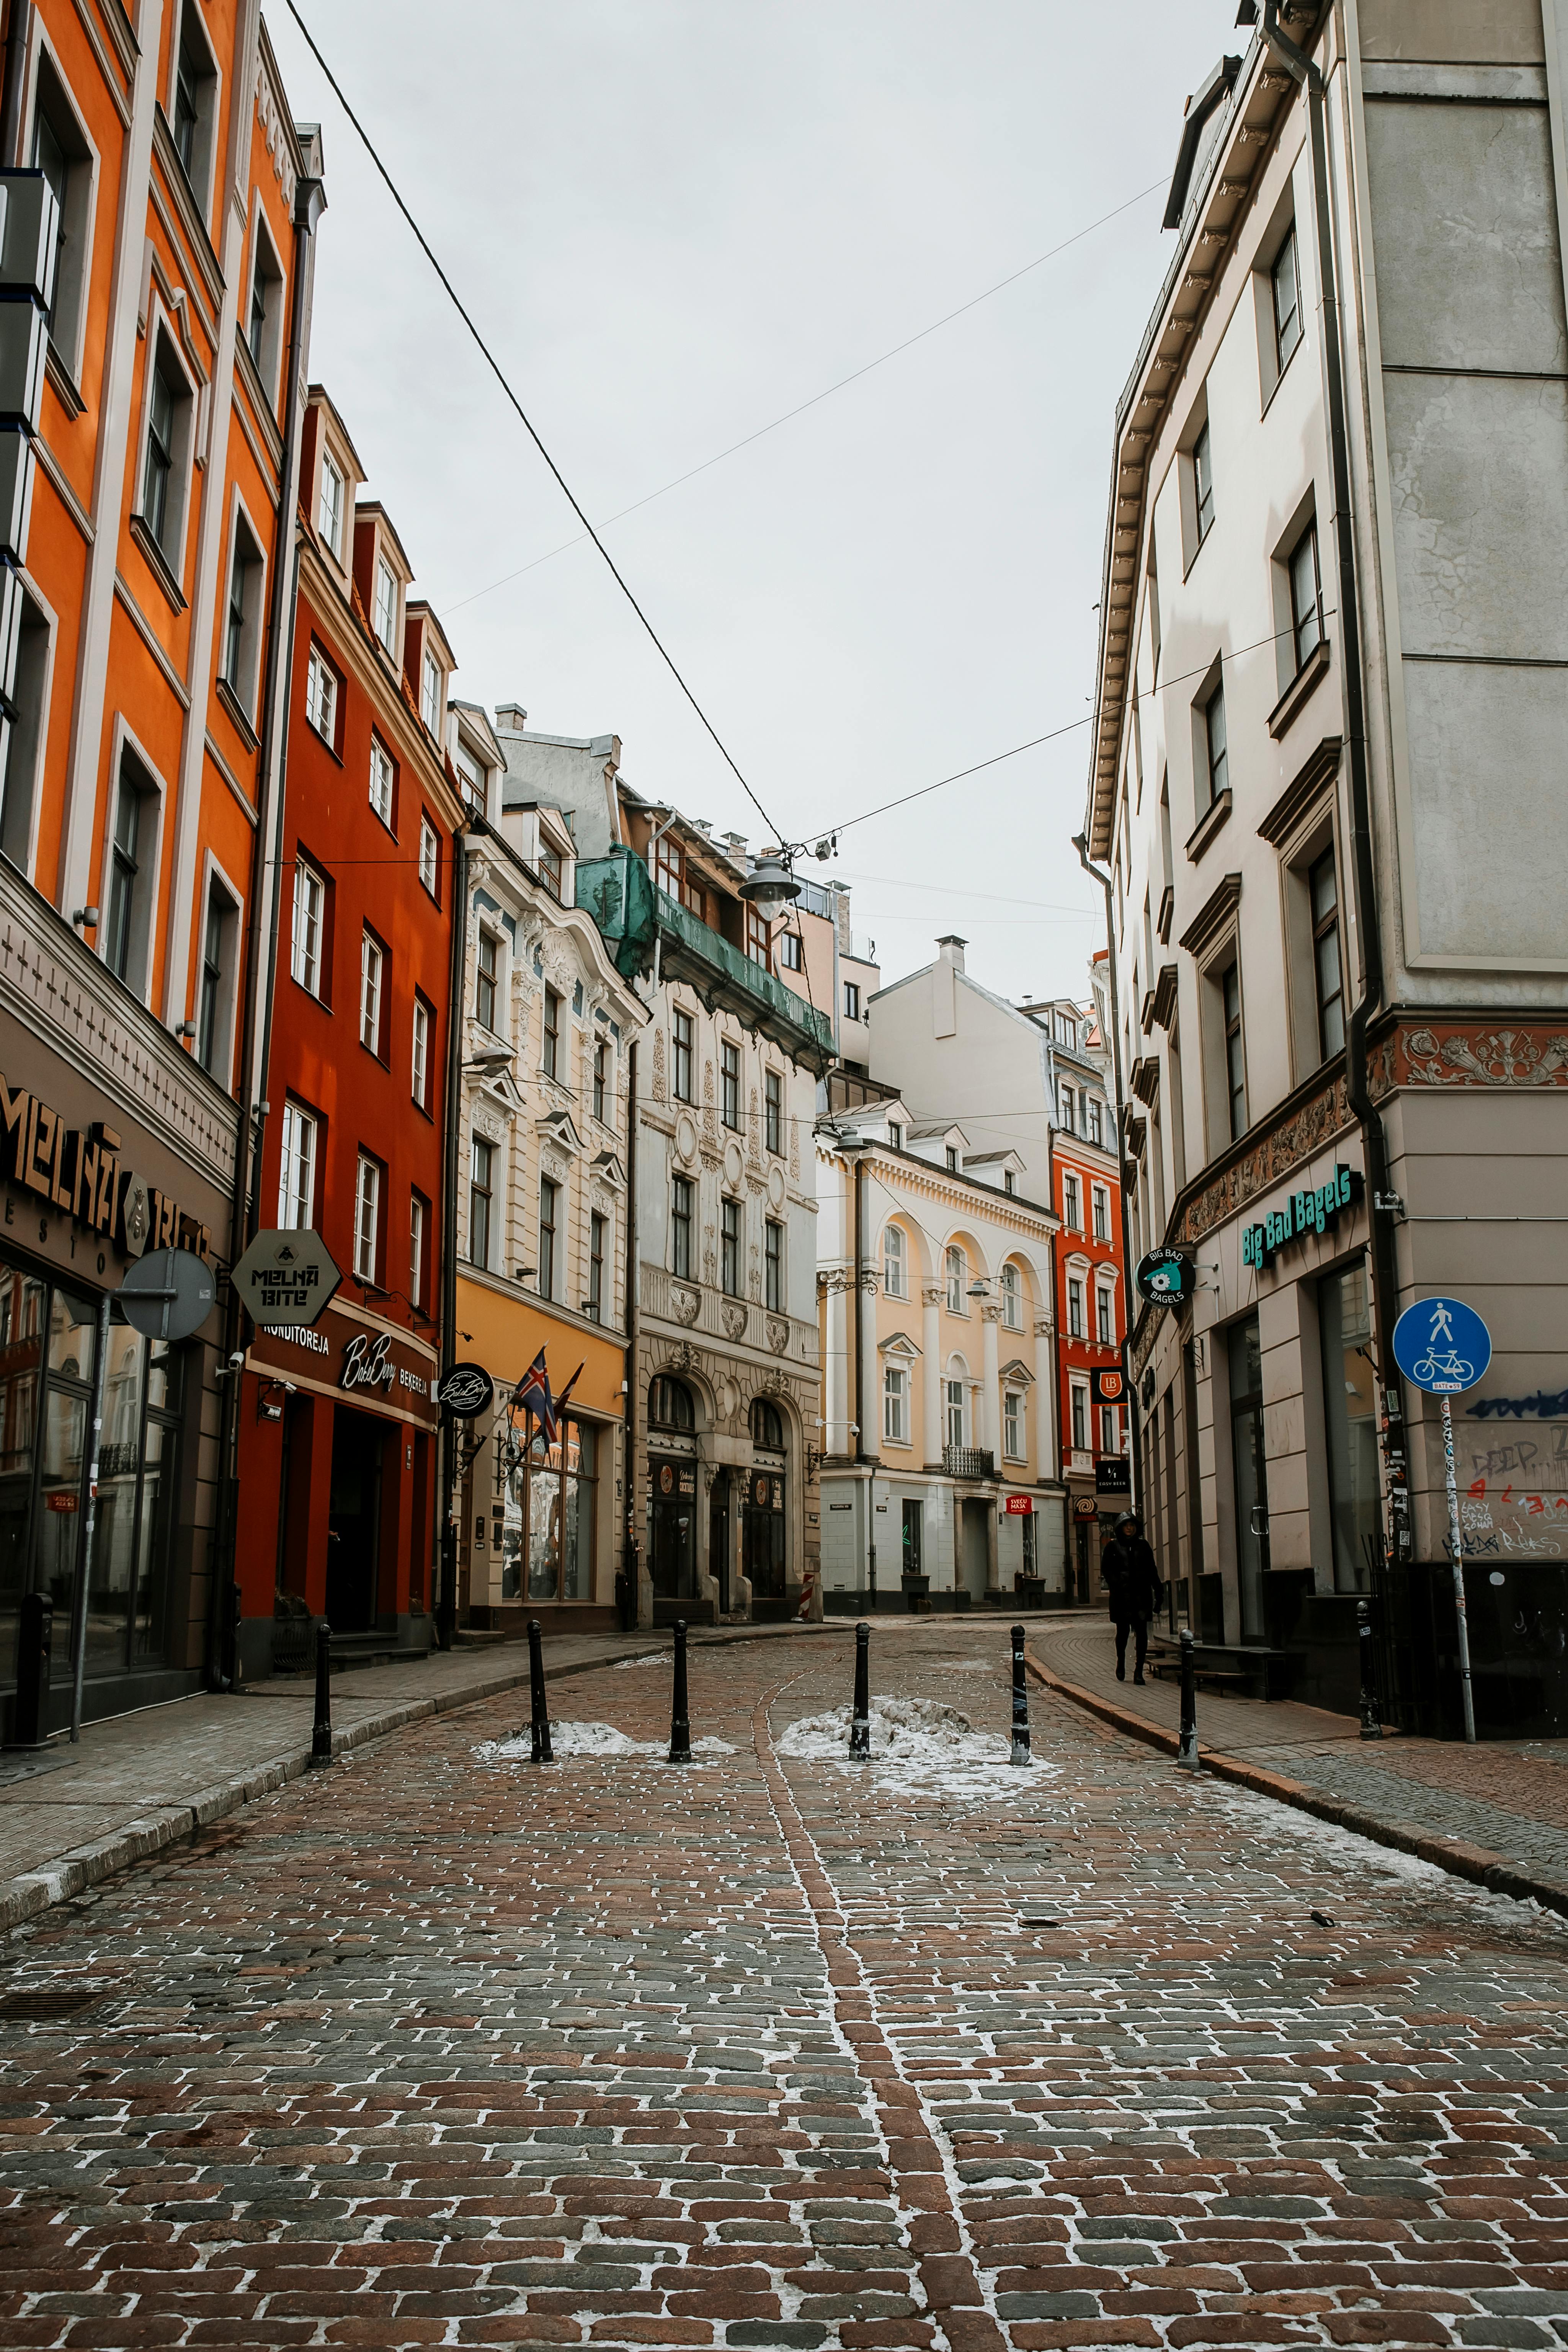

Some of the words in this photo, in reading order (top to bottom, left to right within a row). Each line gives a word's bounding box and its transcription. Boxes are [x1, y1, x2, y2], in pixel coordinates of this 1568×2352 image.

[1242, 1223, 1262, 1269] Big
[1266, 1196, 1292, 1250] Bad
[1295, 1163, 1351, 1233] Bagels
[1149, 1250, 1163, 1261] BIG
[1165, 1249, 1183, 1261] BAD
[252, 1265, 318, 1286] MELNĀ
[261, 1290, 308, 1306] BITE
[1150, 1291, 1184, 1303] BAGELS
[400, 1368, 427, 1396] BEĶEREJA
[1105, 1377, 1117, 1389] LB
[1461, 1501, 1489, 1514] EASY
